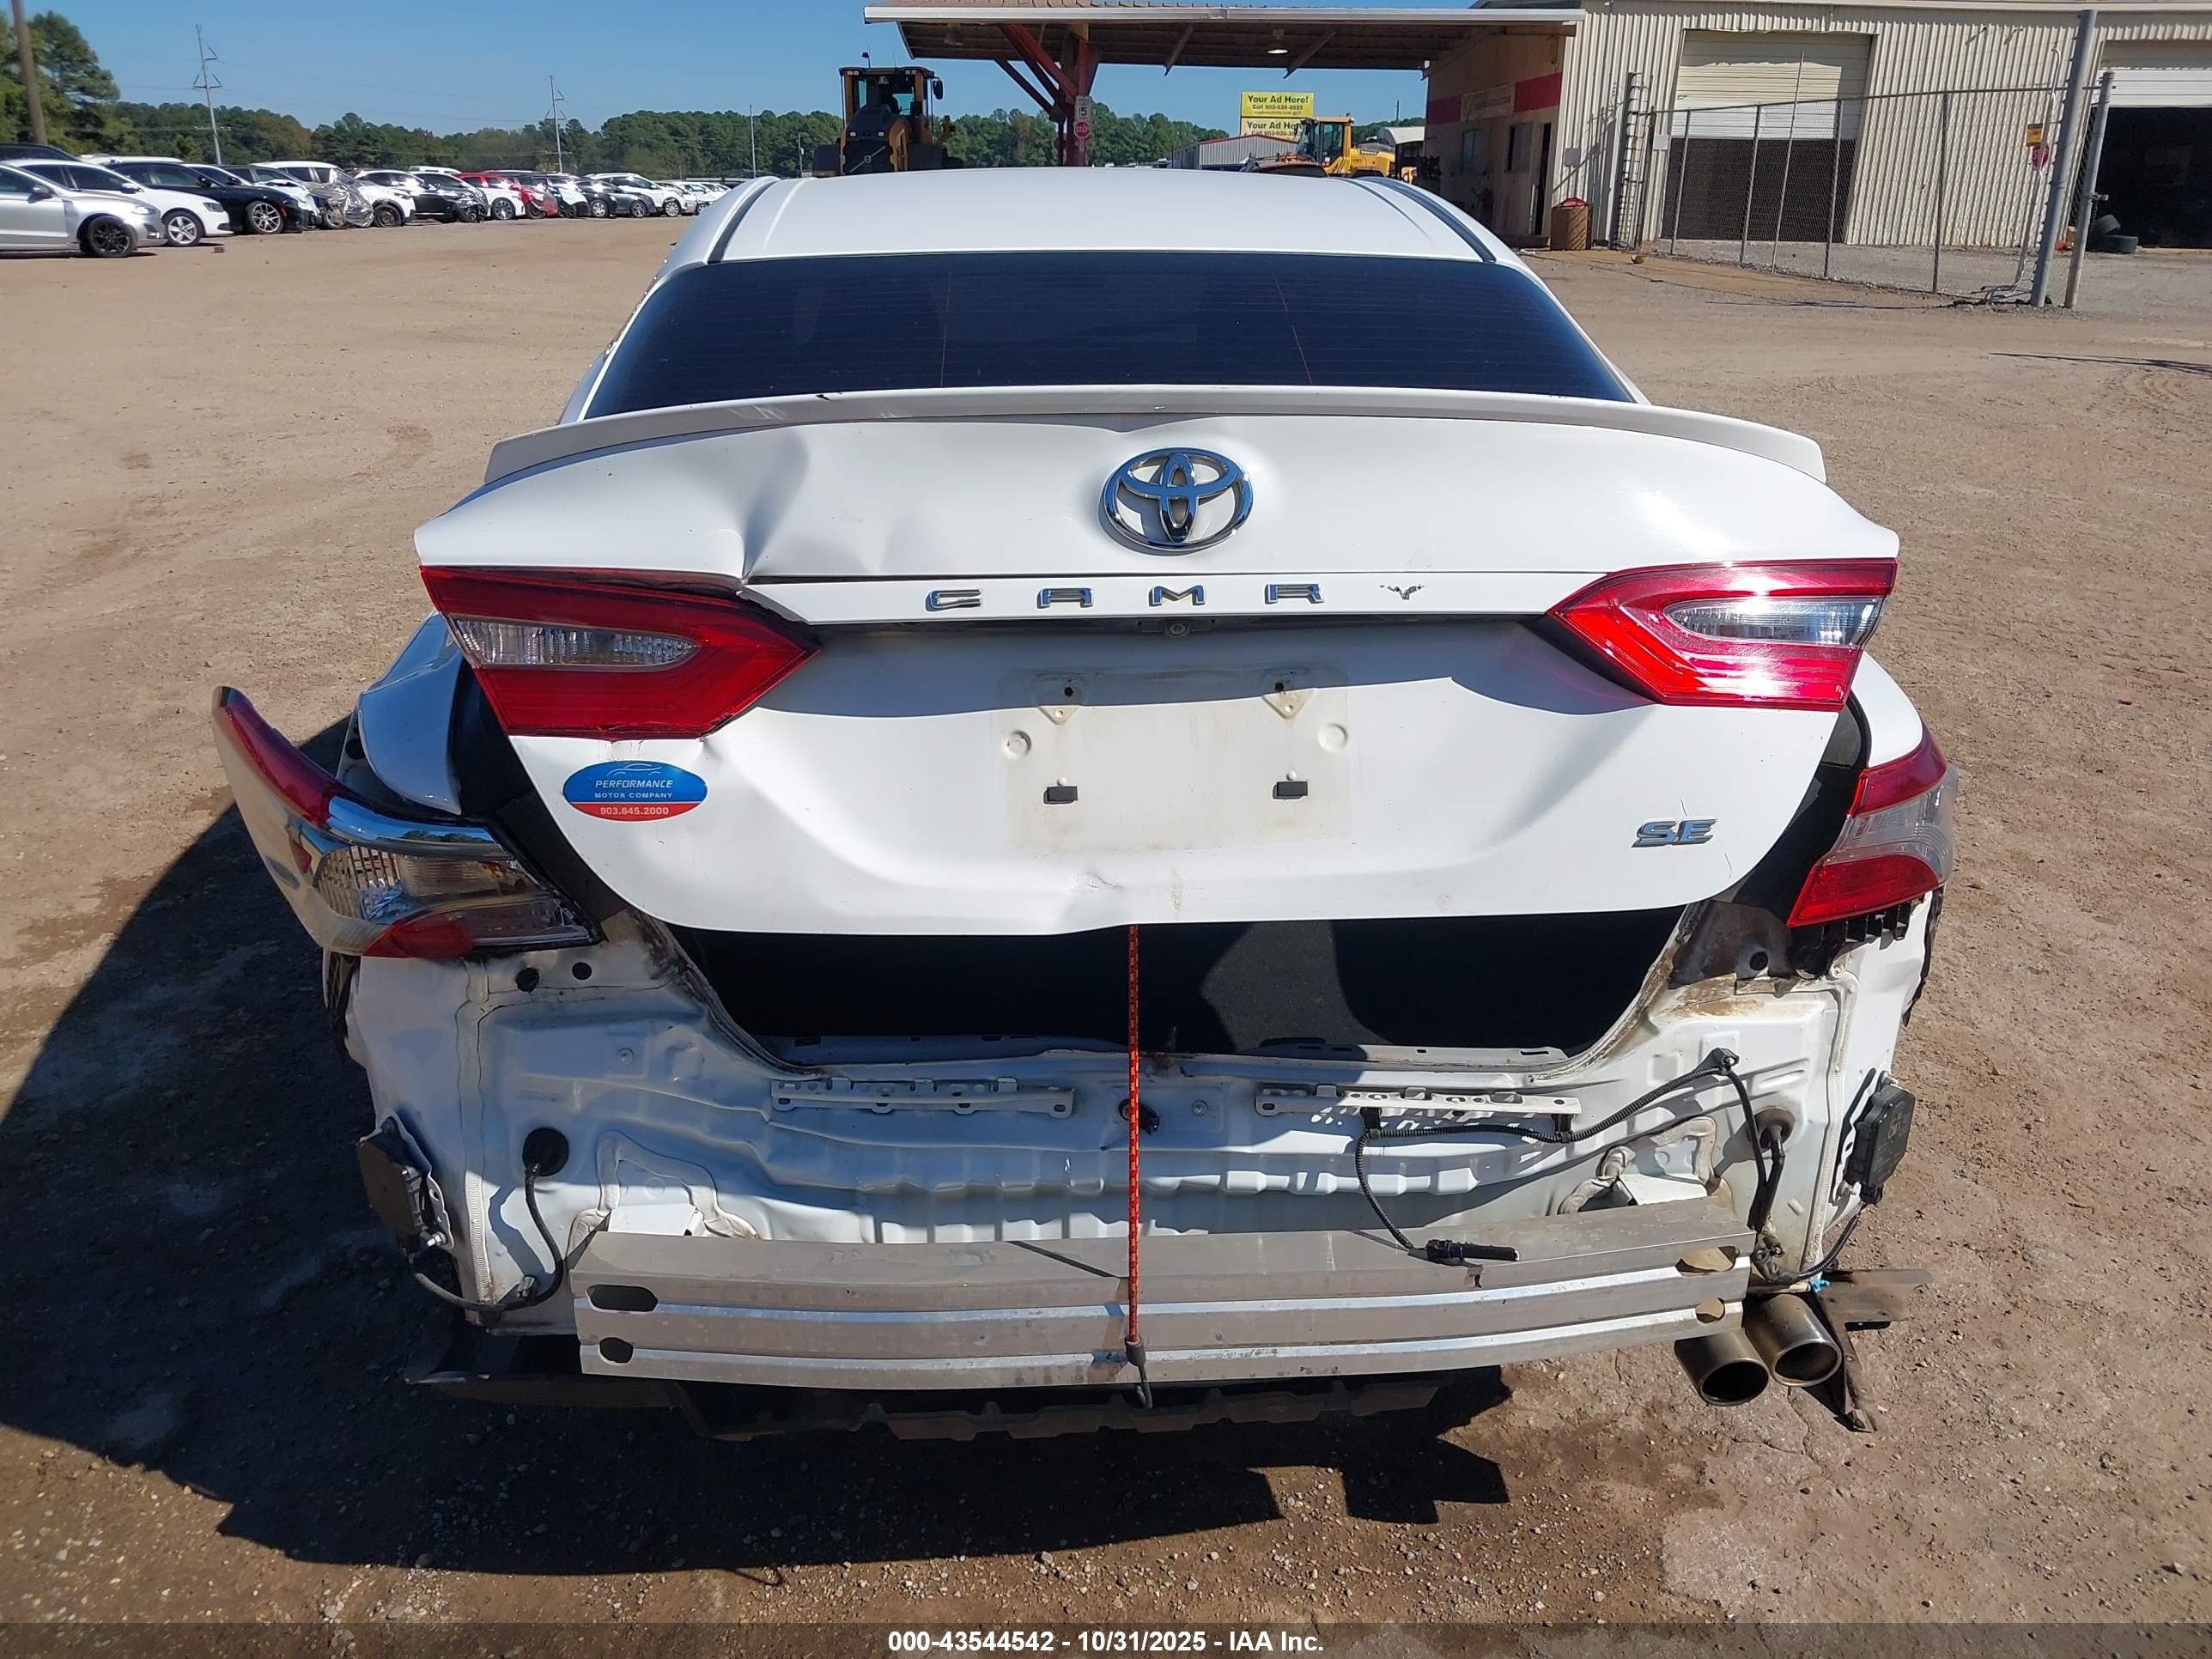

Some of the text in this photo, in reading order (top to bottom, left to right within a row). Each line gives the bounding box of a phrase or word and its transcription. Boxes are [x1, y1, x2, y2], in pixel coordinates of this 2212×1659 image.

[595, 780, 674, 788] PERFORMANCE
[600, 806, 670, 816] 903.645.2000
[1631, 818, 1717, 848] SE
